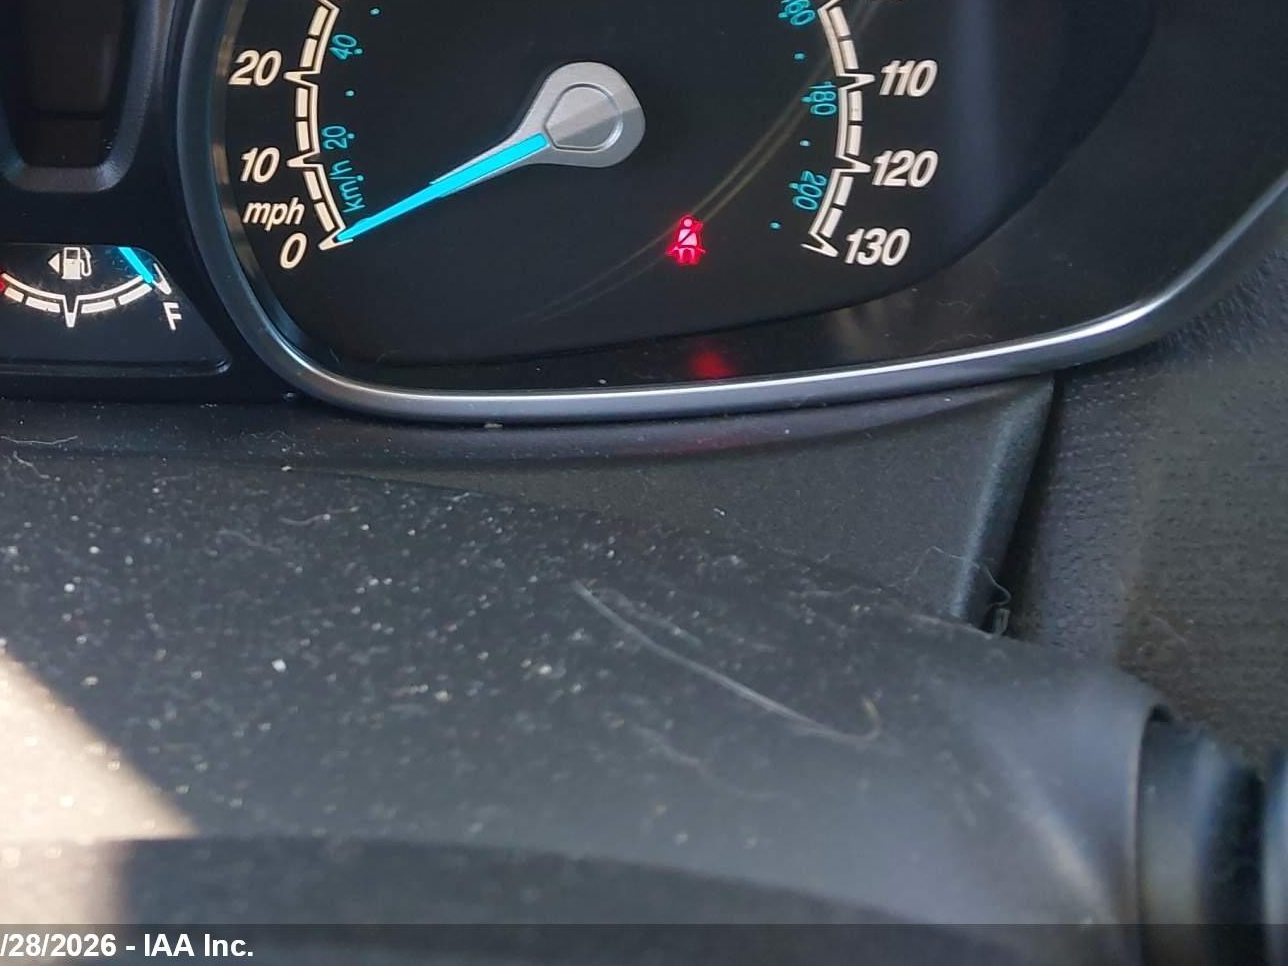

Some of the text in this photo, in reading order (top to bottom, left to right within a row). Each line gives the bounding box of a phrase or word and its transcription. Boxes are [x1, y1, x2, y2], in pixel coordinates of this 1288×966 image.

[330, 34, 355, 60] 40
[228, 50, 281, 87] 20
[878, 59, 938, 97] 110
[811, 81, 837, 116] 180
[321, 125, 348, 150] 20
[239, 146, 280, 184] 10
[872, 149, 939, 188] 120
[329, 159, 366, 213] km/h
[792, 170, 827, 211] 200
[243, 200, 305, 228] mph
[280, 233, 307, 269] 0
[844, 228, 911, 266] 130
[162, 301, 182, 331] F
